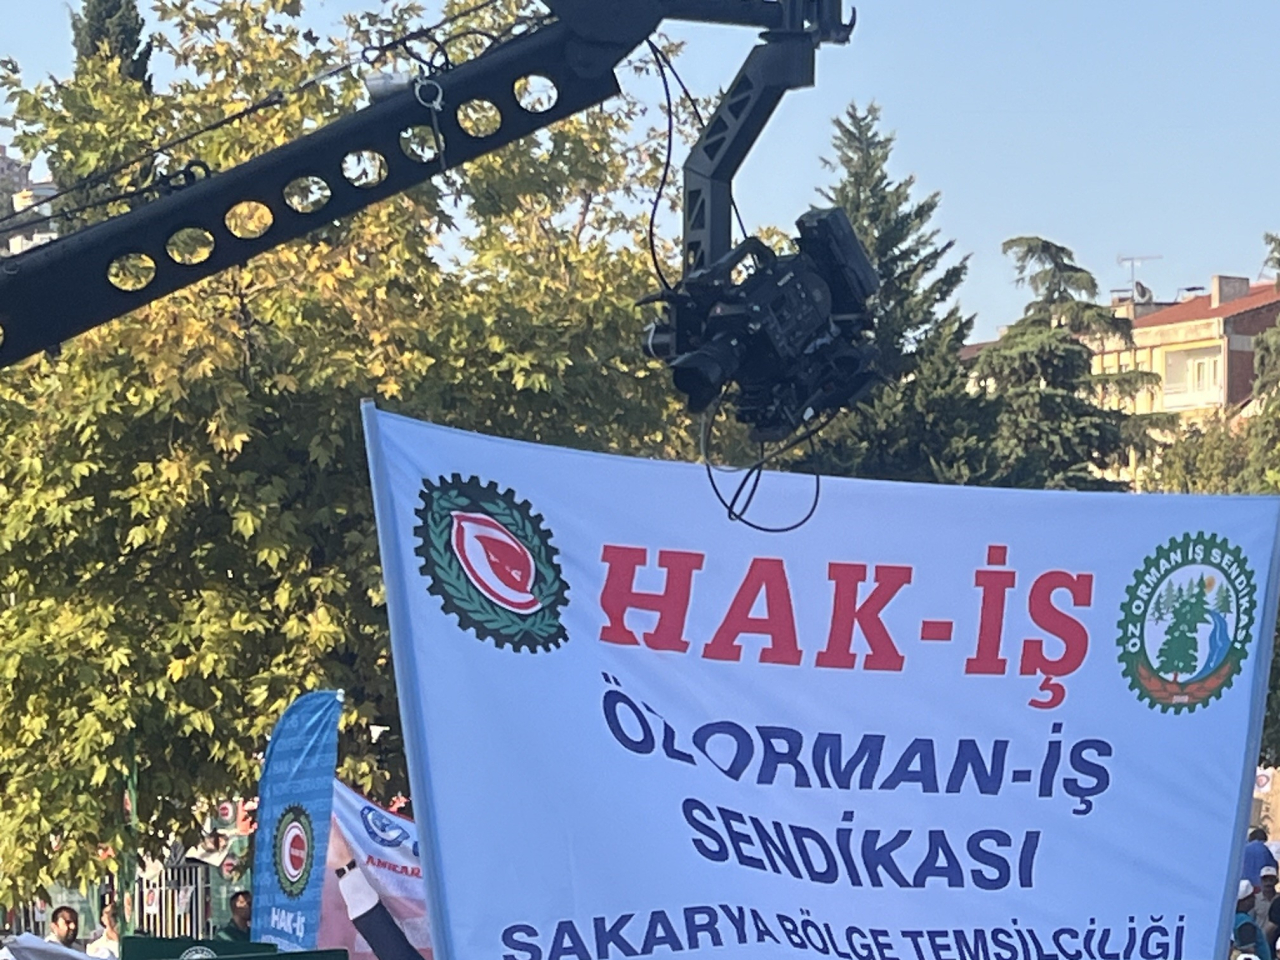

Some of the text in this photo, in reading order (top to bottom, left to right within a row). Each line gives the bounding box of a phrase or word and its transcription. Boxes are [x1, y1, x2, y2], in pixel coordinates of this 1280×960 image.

[1132, 549, 1182, 615] ORMAN
[599, 544, 1094, 709] HAK-İŞ
[366, 854, 422, 878] ANKAR
[682, 798, 1041, 890] SENDİKASI
